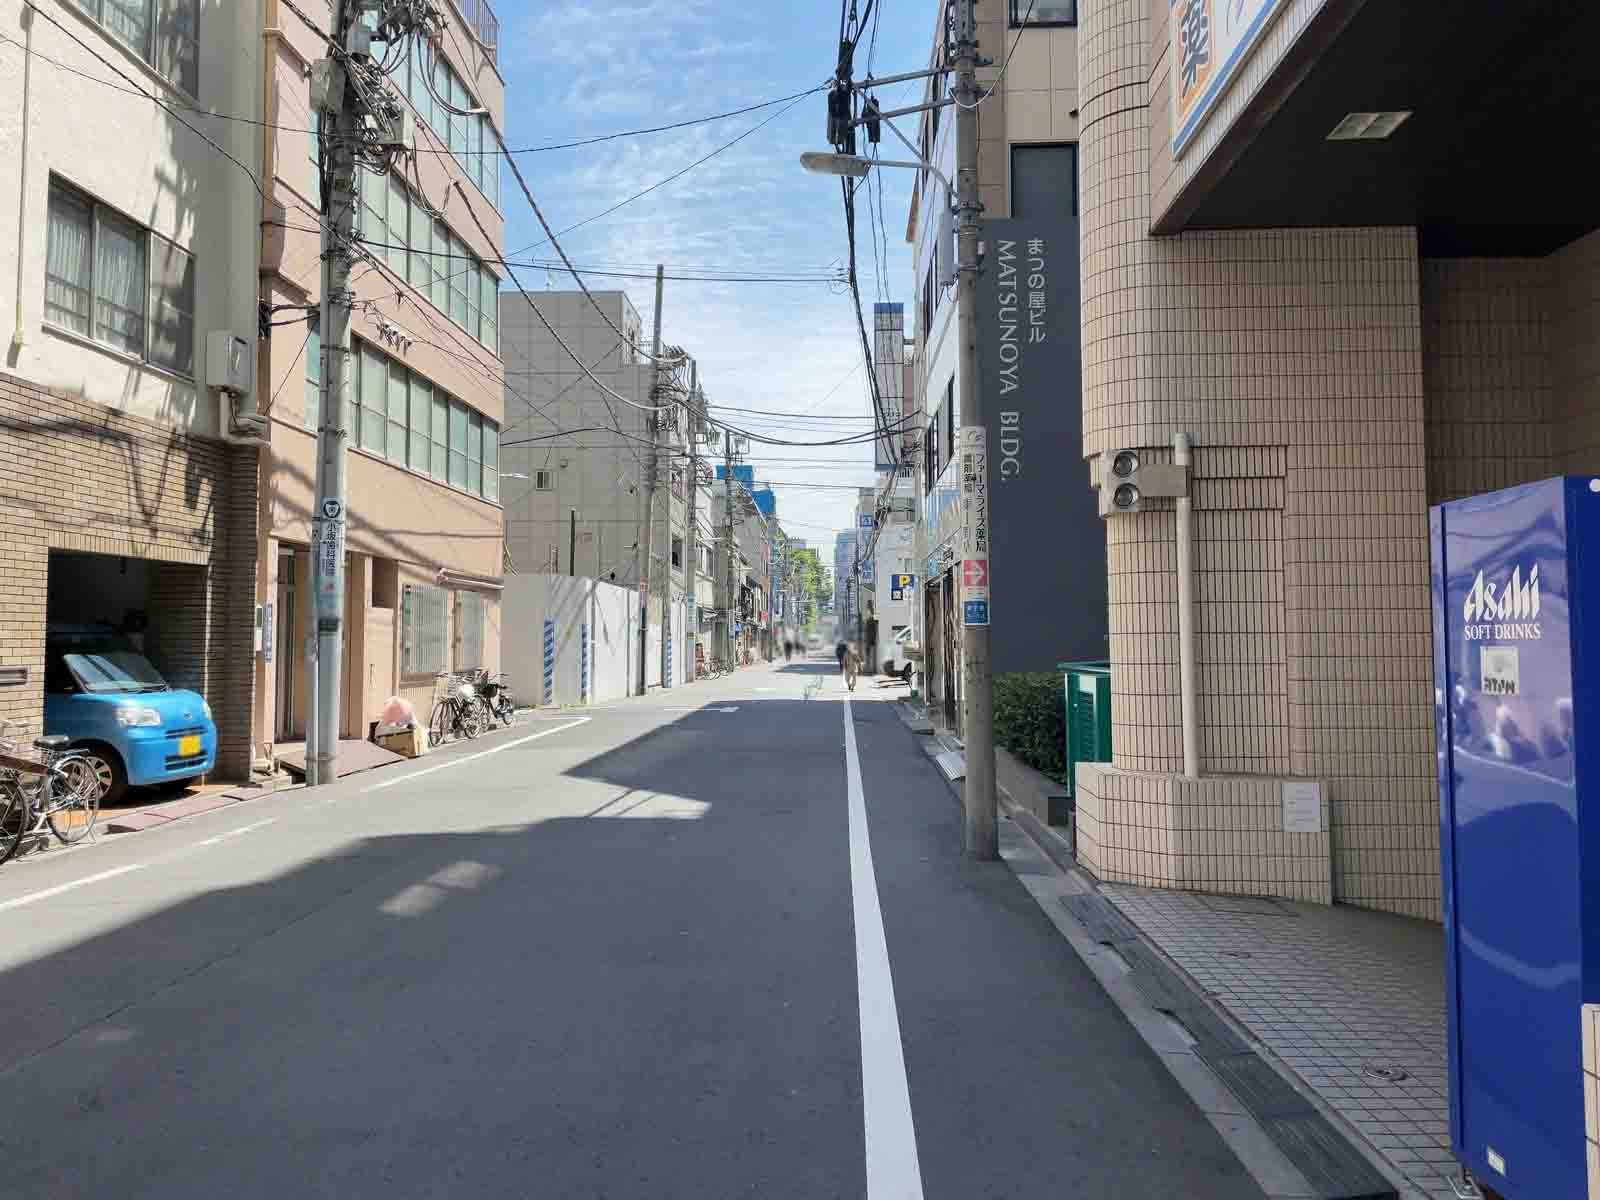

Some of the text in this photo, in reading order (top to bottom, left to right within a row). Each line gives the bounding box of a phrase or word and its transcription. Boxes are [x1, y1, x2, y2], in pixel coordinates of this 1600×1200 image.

[1026, 237, 1046, 344] まつの屋ビル
[998, 239, 1020, 481] MATSUNOYA BLDG.
[898, 575, 910, 588] P
[1463, 562, 1540, 622] Asahi
[1464, 623, 1541, 641] SOFT DRINKS
